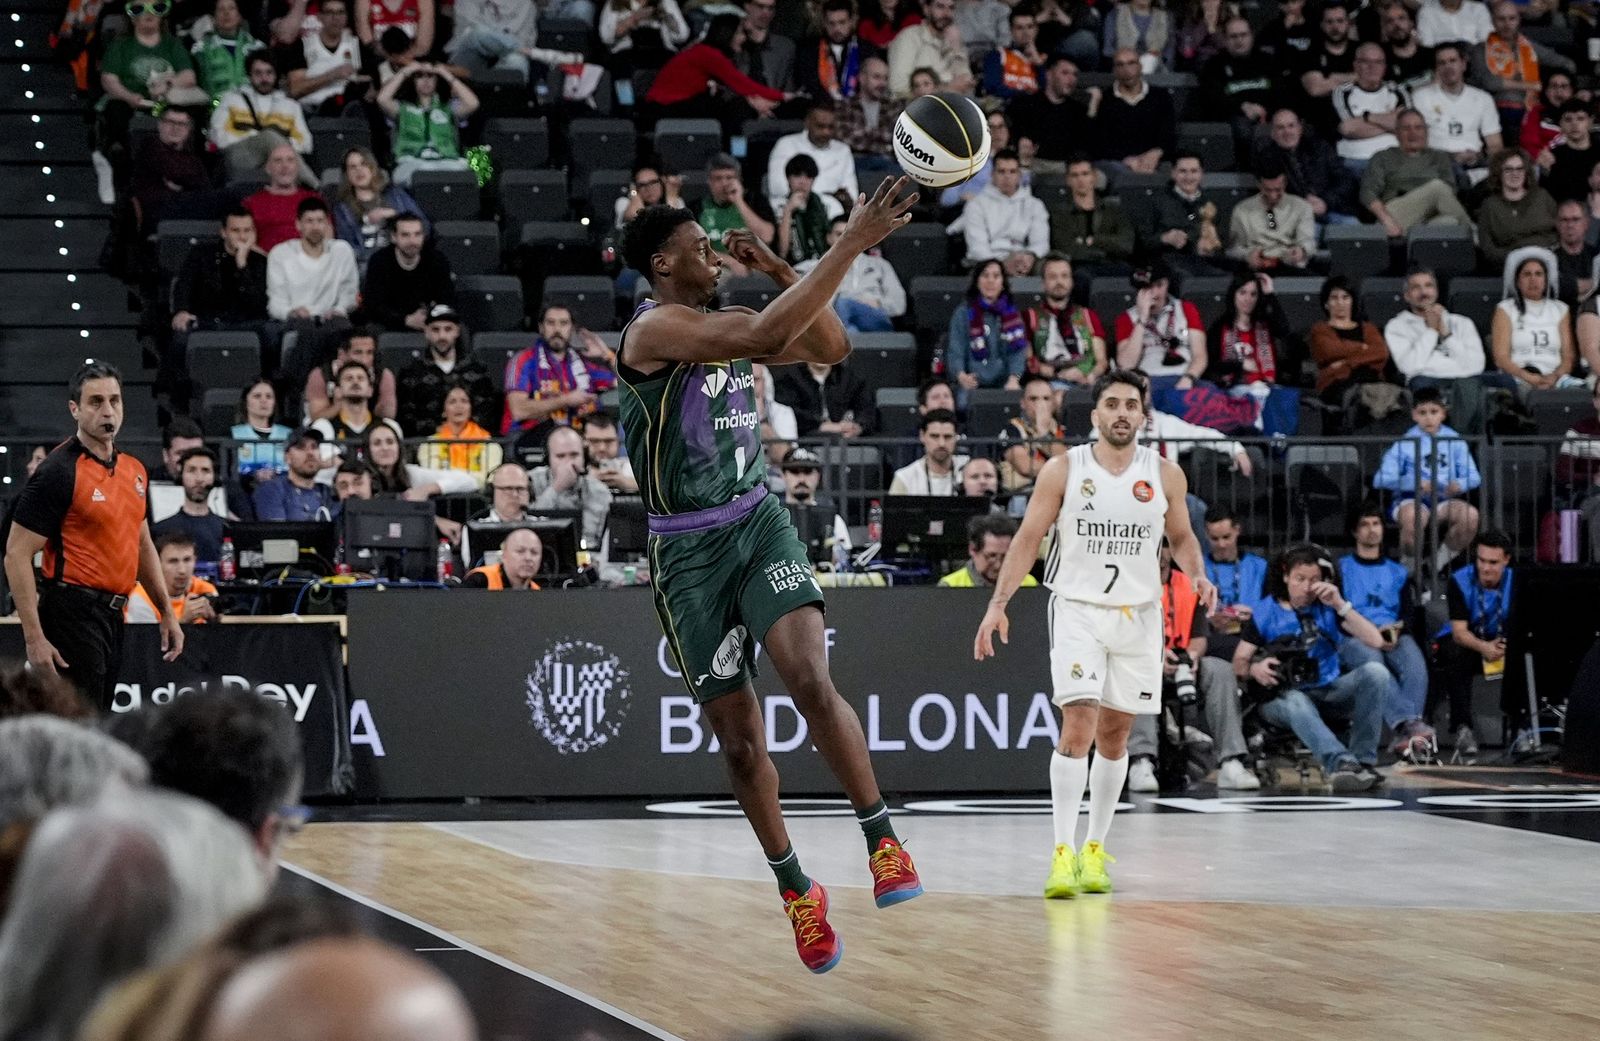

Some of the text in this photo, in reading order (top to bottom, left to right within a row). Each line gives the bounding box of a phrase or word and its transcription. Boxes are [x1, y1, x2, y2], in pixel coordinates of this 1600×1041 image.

[1076, 518, 1152, 539] Emirates
[1086, 539, 1142, 555] FLY BETTER
[1103, 564, 1120, 594] 7
[660, 692, 1060, 754] BDLONA
